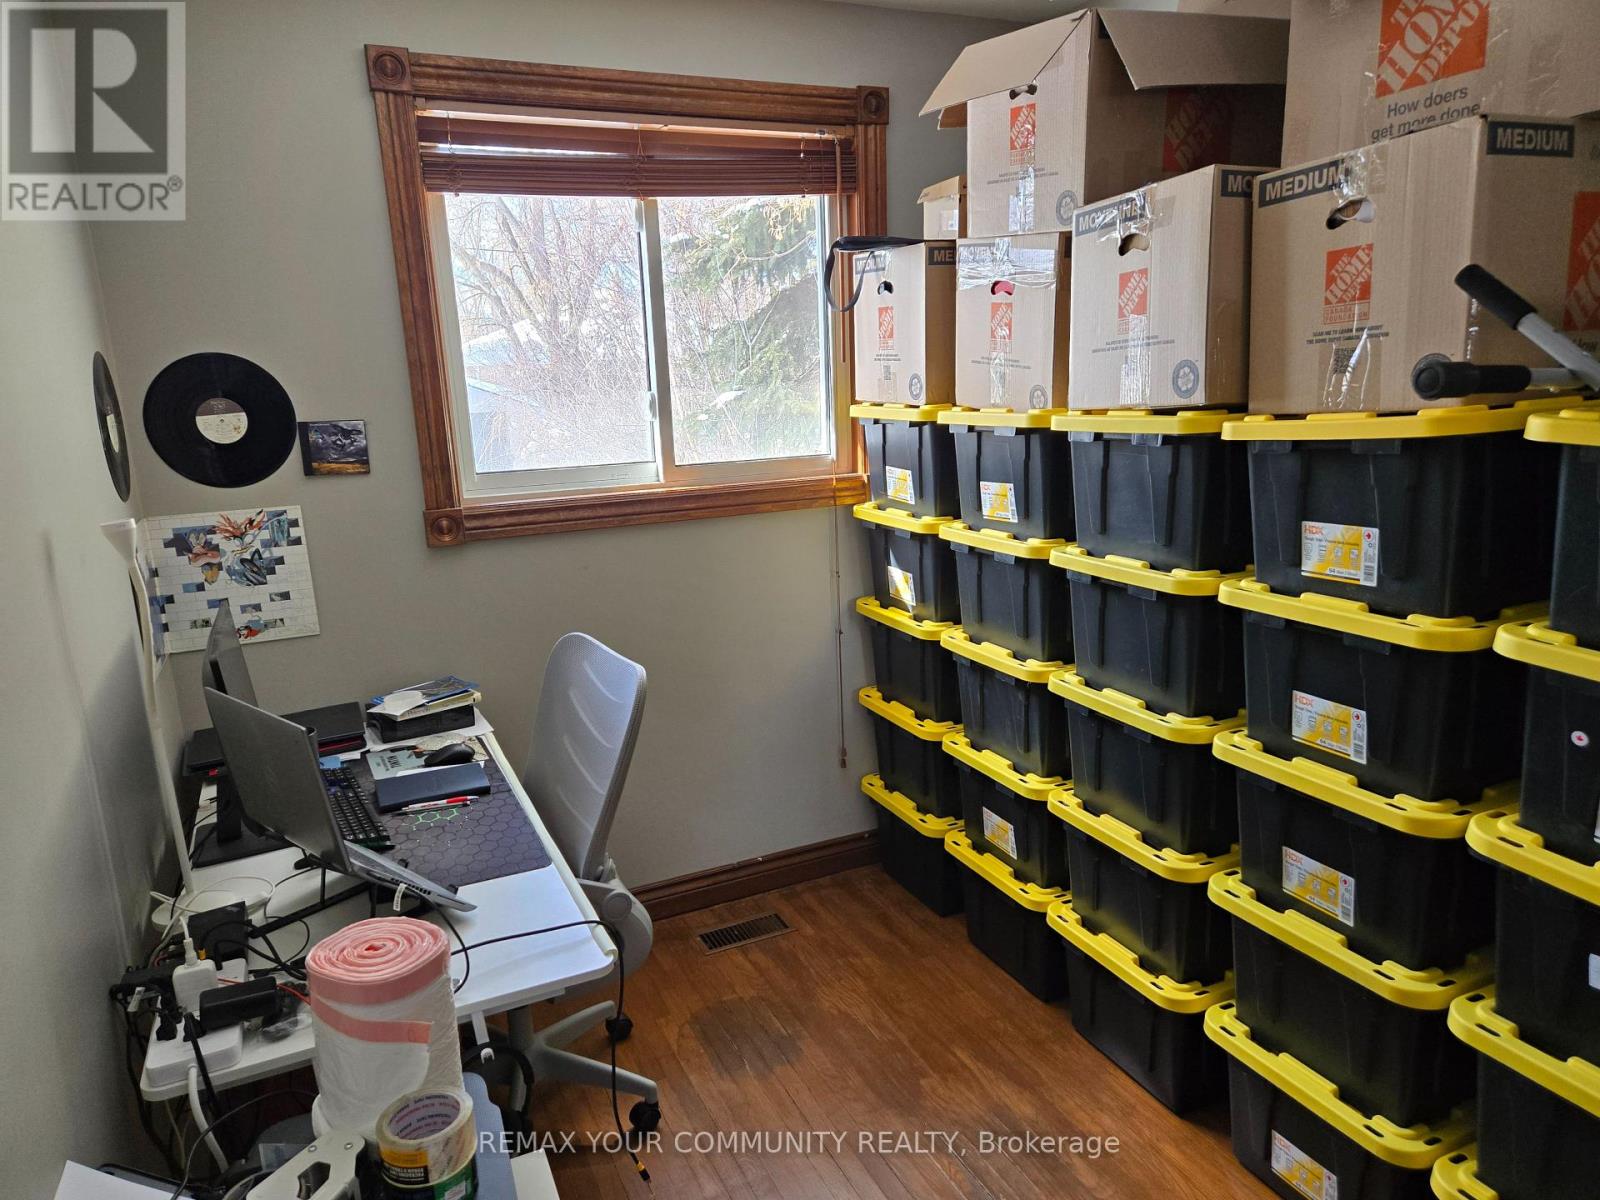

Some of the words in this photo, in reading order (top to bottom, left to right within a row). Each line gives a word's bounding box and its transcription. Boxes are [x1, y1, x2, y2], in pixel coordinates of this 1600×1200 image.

[1387, 100, 1419, 118] How
[1424, 86, 1468, 108] doers
[1371, 122, 1395, 143] get
[1496, 127, 1571, 152] MEDIUM
[1265, 165, 1346, 201] MEDIUM
